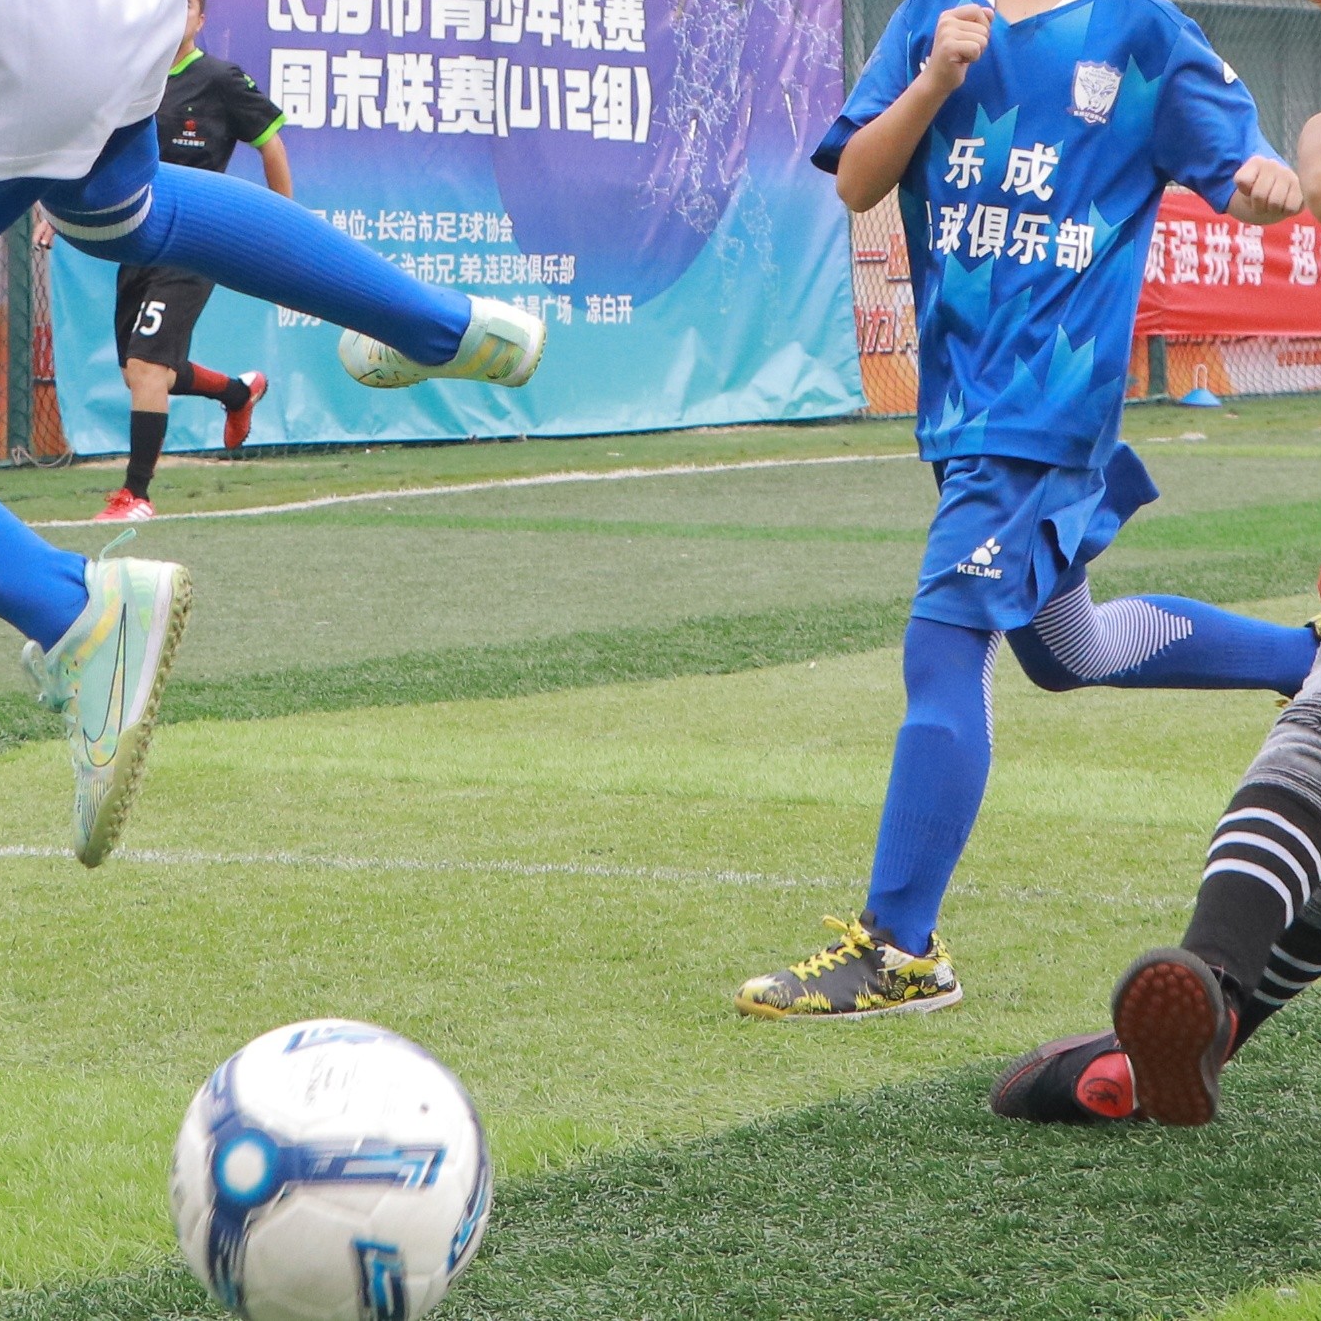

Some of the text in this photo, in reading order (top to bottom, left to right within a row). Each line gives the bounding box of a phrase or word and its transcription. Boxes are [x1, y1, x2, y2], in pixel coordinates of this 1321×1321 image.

[944, 137, 1059, 202] 乐成
[925, 201, 1095, 273] 球俱乐部
[132, 300, 166, 336] 5
[585, 294, 633, 325] 凉白开
[957, 563, 1003, 579] KELME
